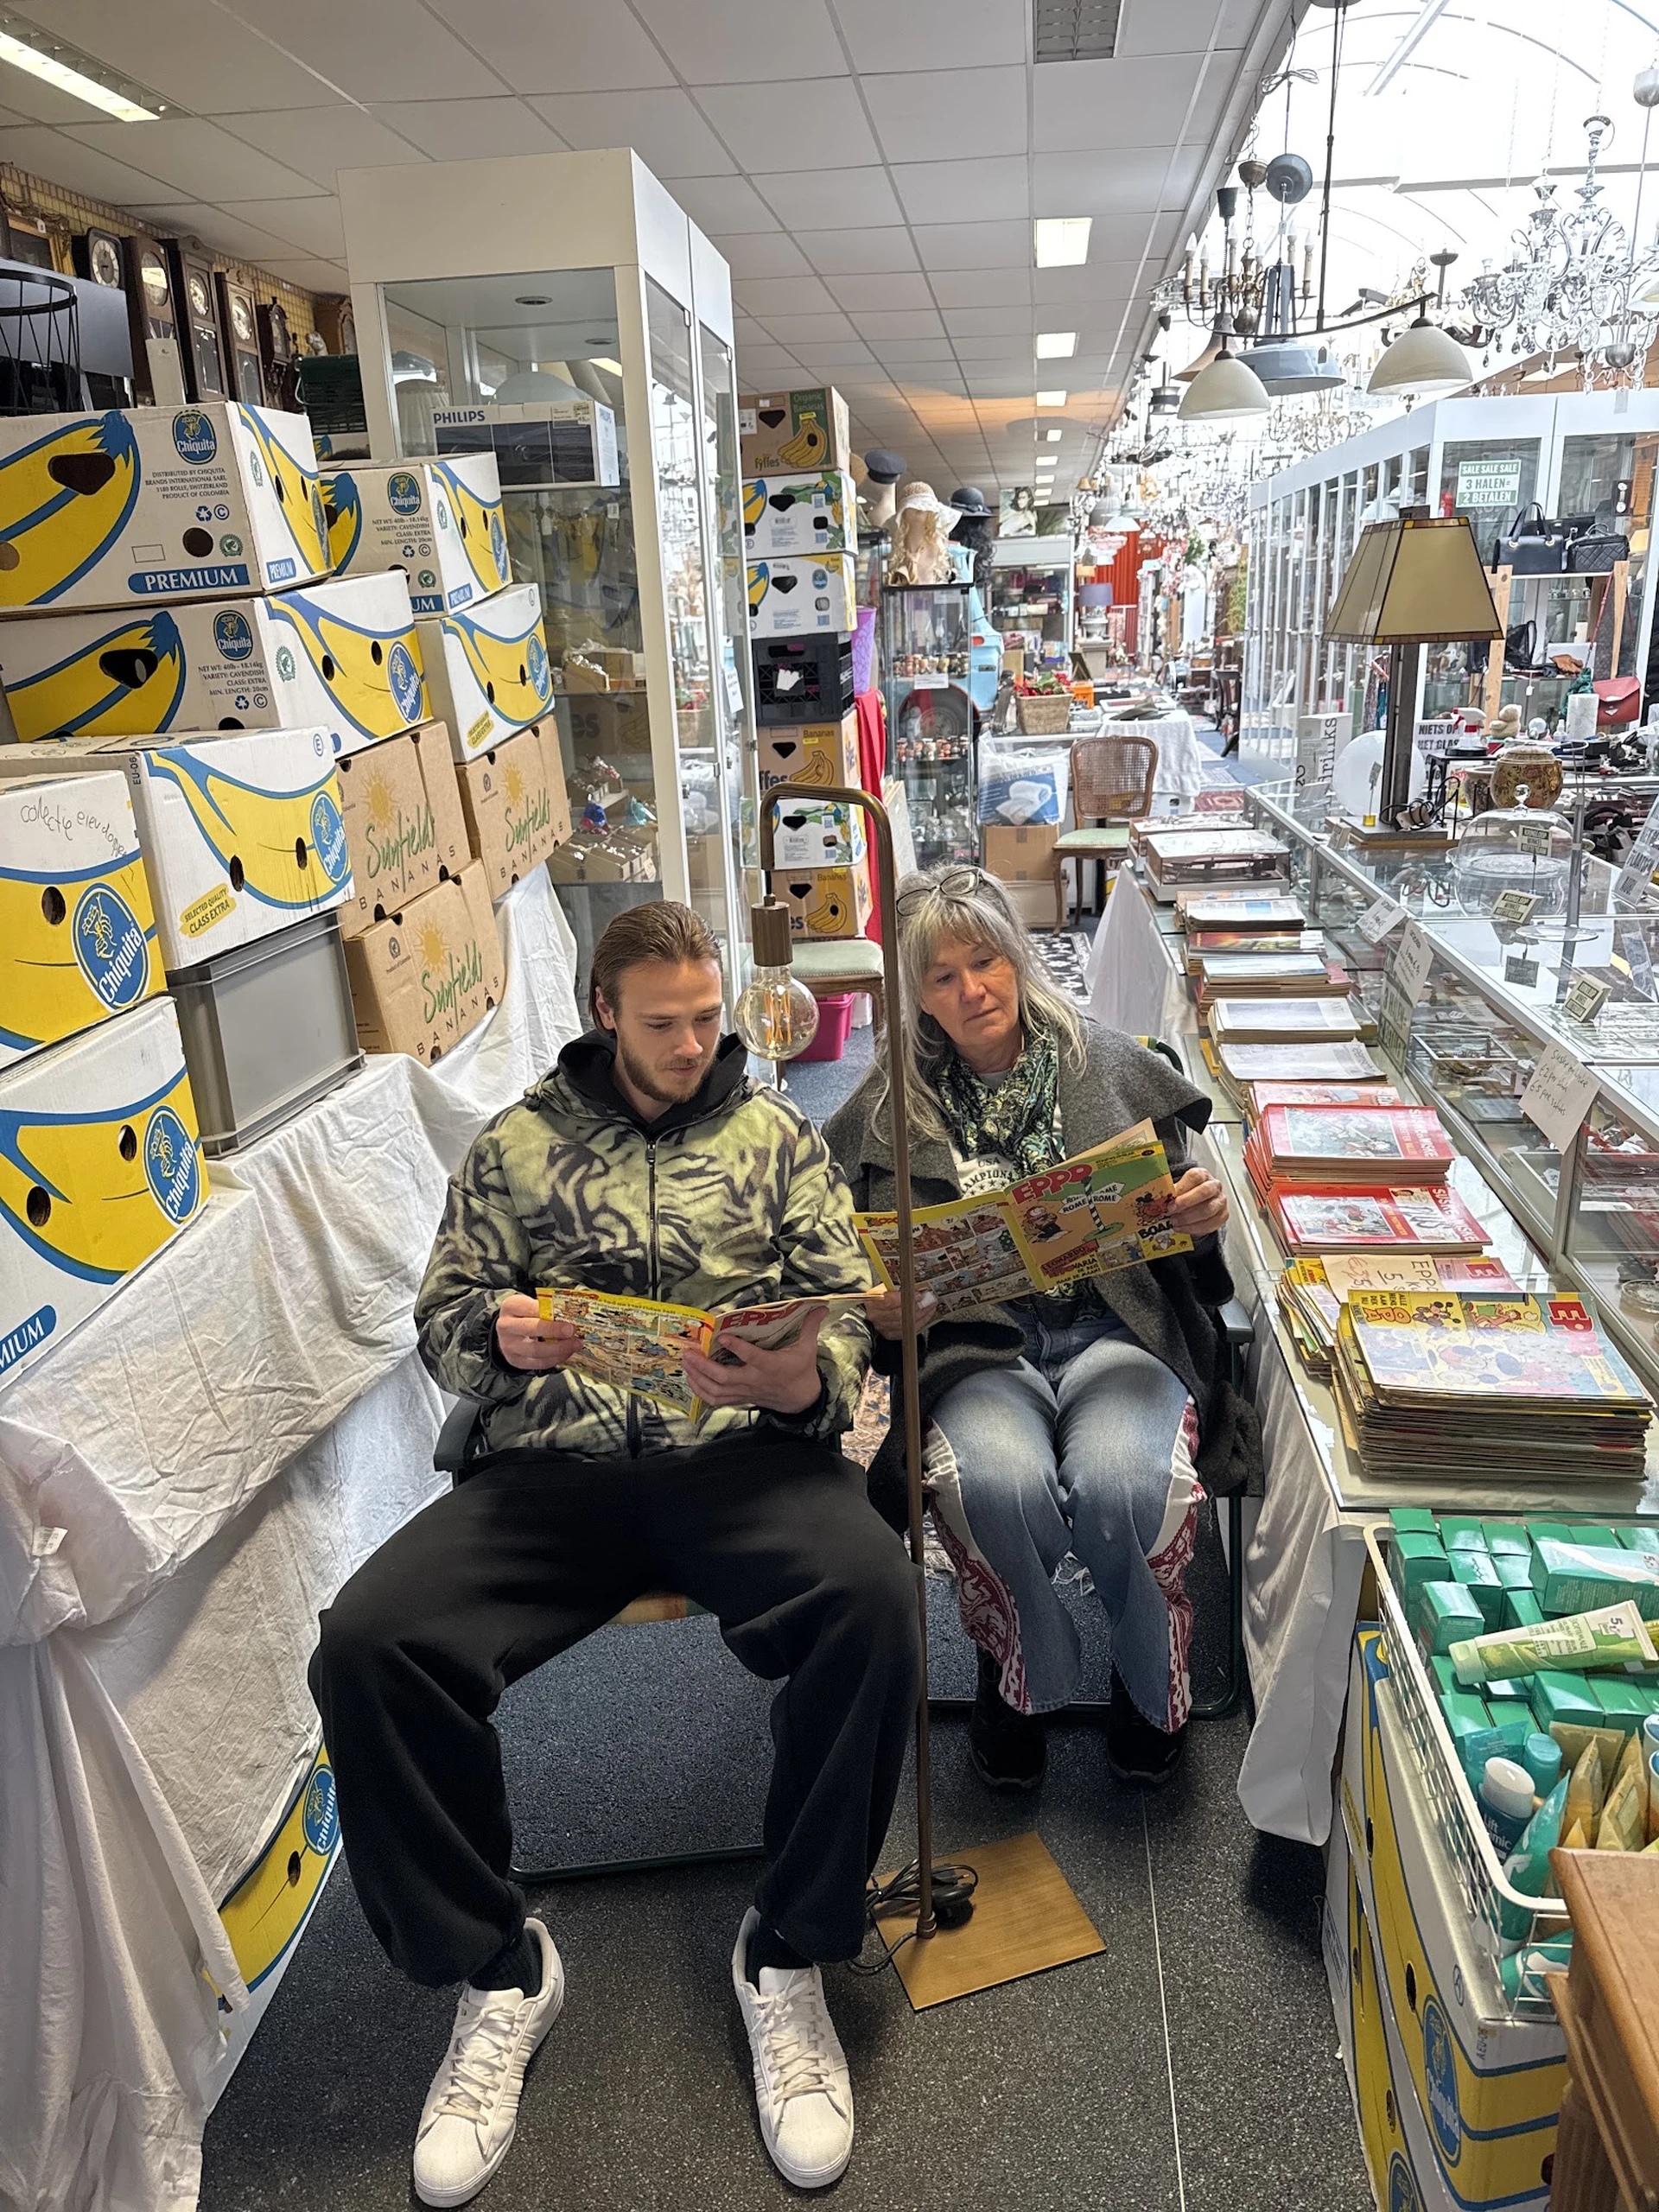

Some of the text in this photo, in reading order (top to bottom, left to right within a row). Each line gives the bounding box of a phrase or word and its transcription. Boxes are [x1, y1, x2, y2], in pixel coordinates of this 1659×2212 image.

[434, 410, 486, 424] PHILIPS
[176, 440, 216, 454] Chiquita
[1462, 463, 1517, 474] SALE SALE SALE
[168, 476, 213, 485] INTERNATIONAL
[190, 482, 228, 491] SWITZERLAND
[1465, 479, 1472, 490] 3
[162, 492, 189, 500] PRODUCT
[391, 496, 421, 508] Chiquita
[1463, 492, 1511, 503] 2 BETALEN
[145, 567, 239, 592] PREMIUM
[268, 560, 296, 582] PREMIUM
[217, 638, 252, 652] Chiquita
[400, 672, 422, 719] Chiquita
[804, 729, 836, 738] Bananas
[1419, 724, 1444, 734] NIETS
[1418, 740, 1434, 750] HET
[133, 756, 142, 785] EU-06
[760, 770, 788, 790] ffes
[322, 826, 346, 877] Chiquita
[365, 803, 435, 893] Sunfields
[500, 822, 563, 879] BANANAS
[359, 845, 456, 910] BANANAS
[184, 887, 228, 923] SELECTED QUALITY
[189, 899, 231, 935] CLASS EXTRA
[98, 924, 143, 1004] Chiquita
[422, 939, 483, 1033] Sunfields
[416, 976, 499, 1056] BANANAS
[1551, 1049, 1569, 1068] Suske
[977, 1157, 1001, 1168] USA
[164, 1140, 197, 1218] Chiquita
[1011, 1164, 1093, 1205] EPPO
[1062, 1198, 1088, 1214] ROME
[1092, 1194, 1117, 1203] ROME
[1433, 1188, 1458, 1216] SUSKE
[1453, 1219, 1479, 1242] WISKE
[1379, 1294, 1388, 1306] AAN
[1398, 1290, 1408, 1306] ALLE
[1362, 1306, 1412, 1325] OPA
[1547, 1300, 1604, 1357] EPPO
[0, 1316, 45, 1370] MIUM
[1484, 1813, 1498, 1834] Lift
